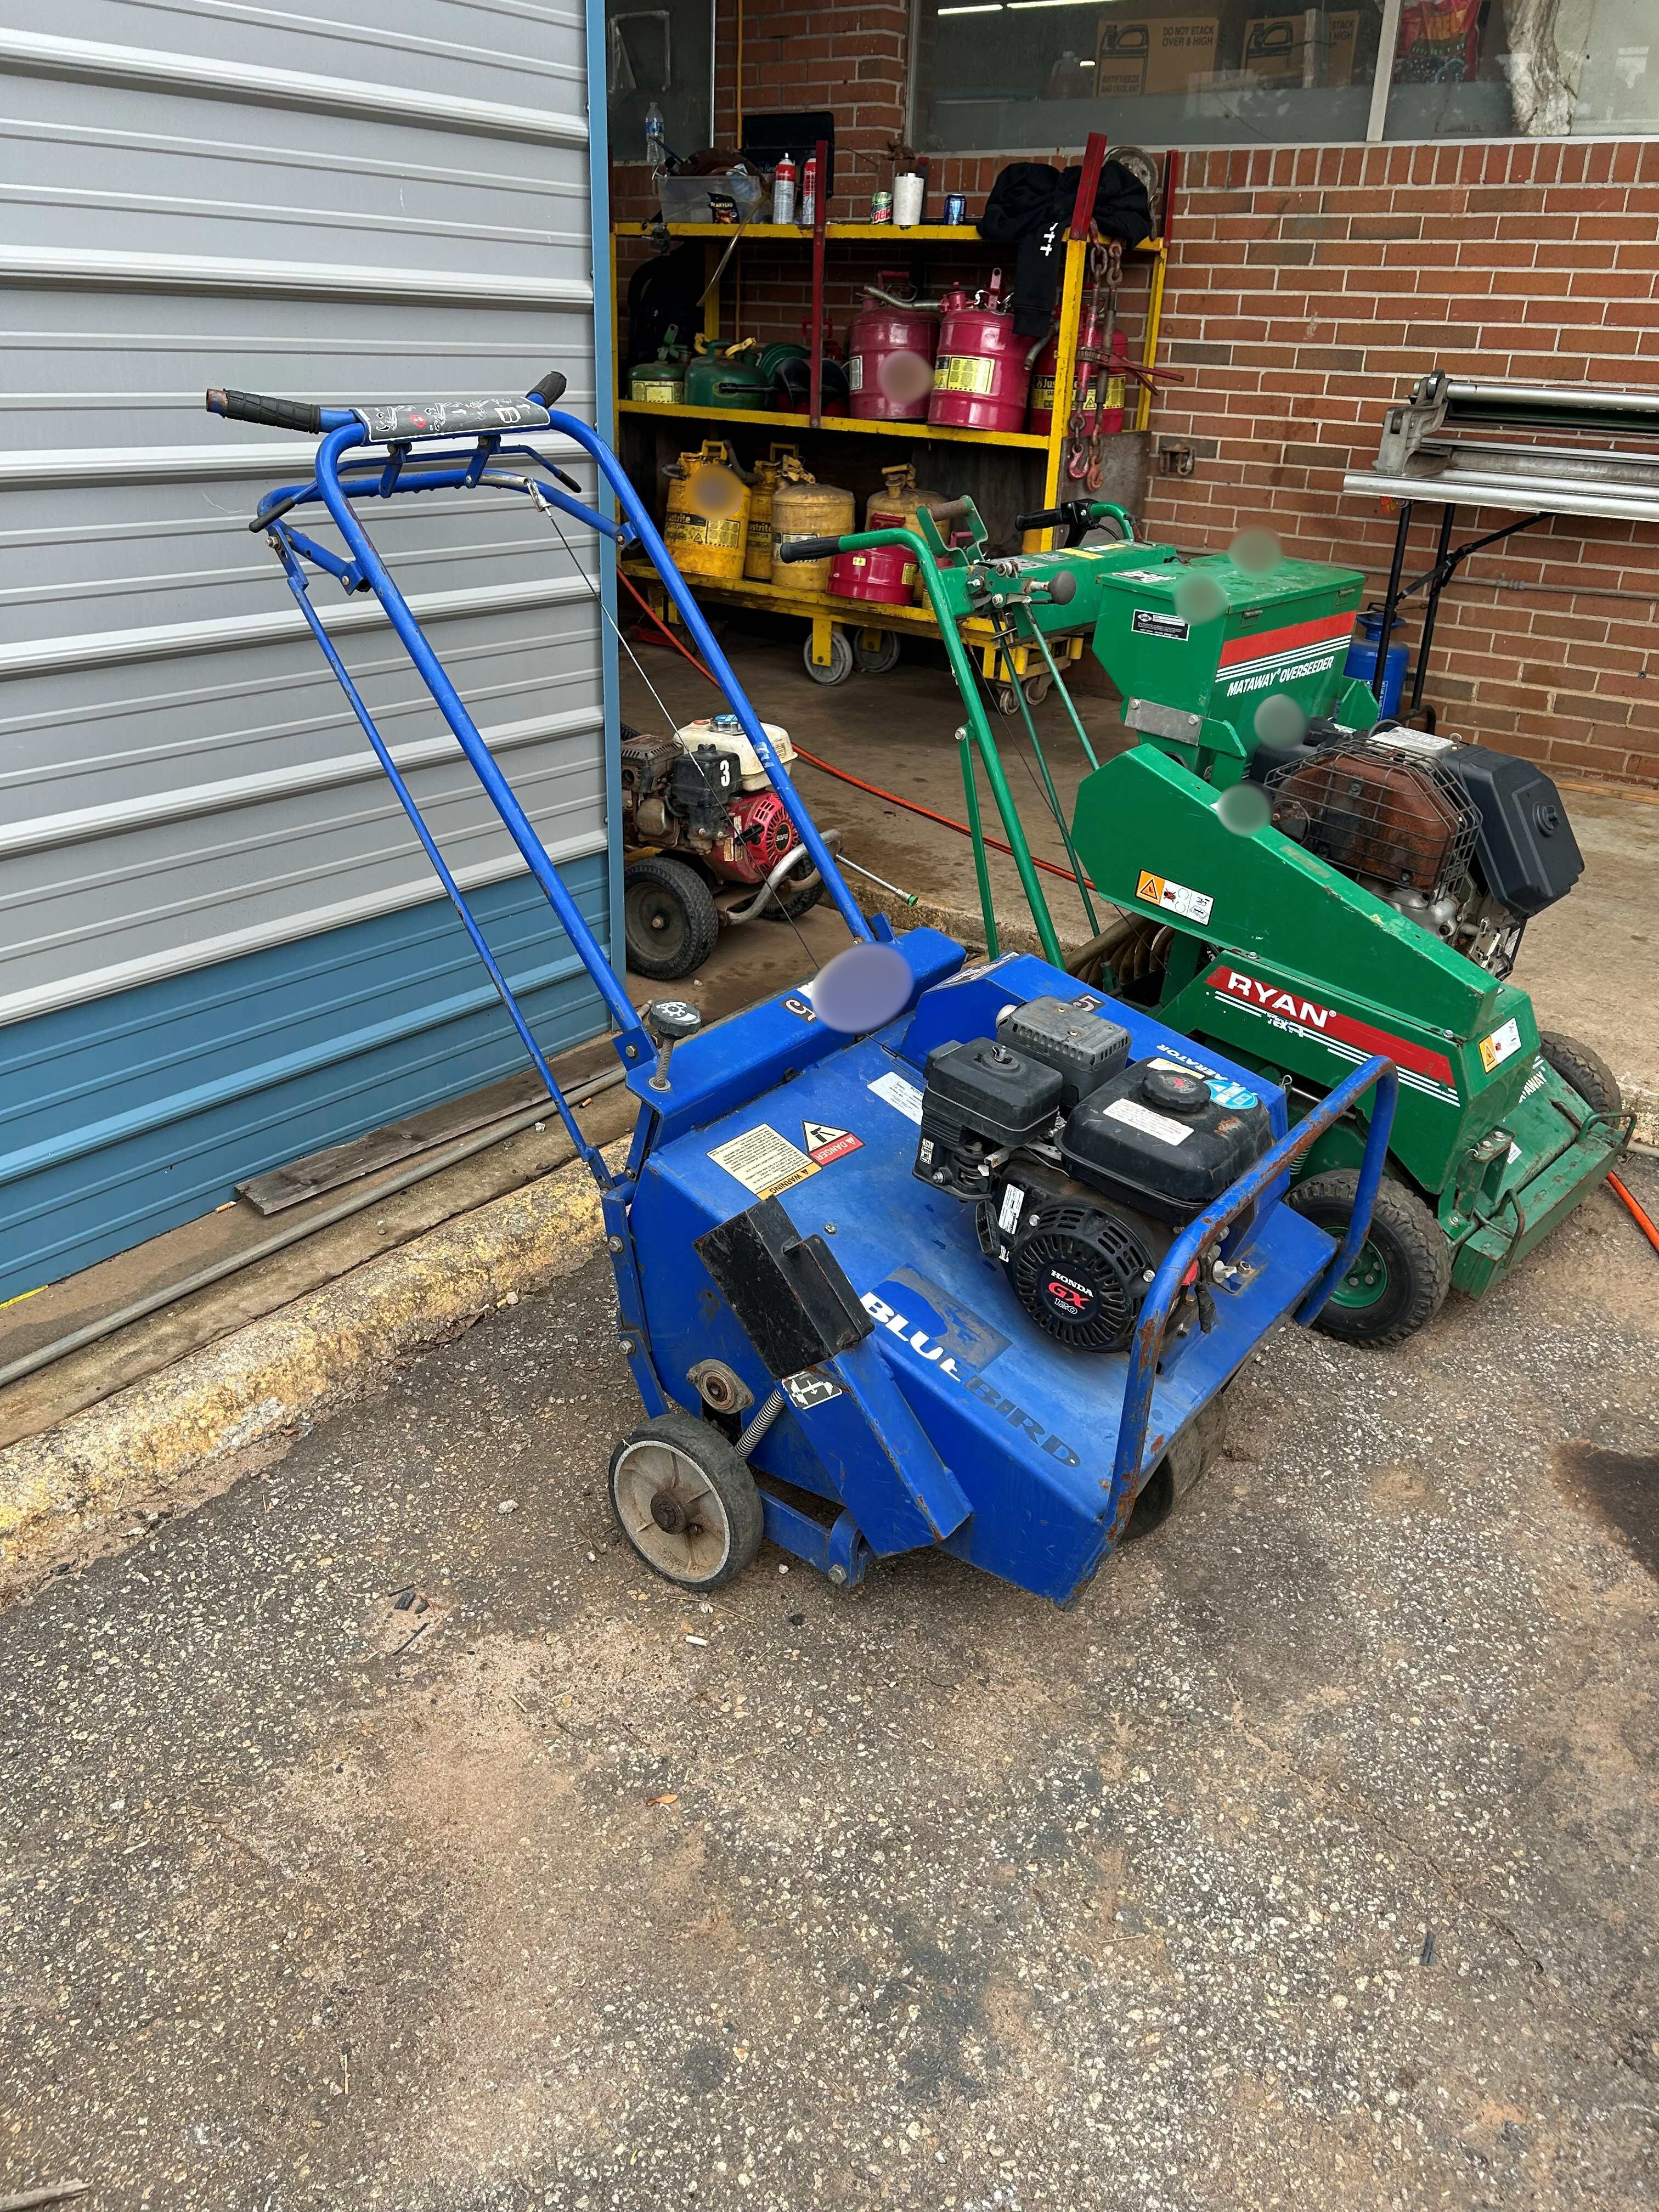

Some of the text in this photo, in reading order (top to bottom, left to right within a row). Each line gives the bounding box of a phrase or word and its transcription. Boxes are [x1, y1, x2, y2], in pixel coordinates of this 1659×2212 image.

[1162, 37, 1184, 47] OVER
[1193, 36, 1213, 46] HIGH
[1163, 25, 1214, 36] DO NOT STACK
[1227, 656, 1334, 697] MATAWAY OVERSEEDER
[719, 759, 731, 787] 3
[1227, 971, 1329, 1028] RYAN
[1156, 1044, 1229, 1080] AERATOR
[816, 1140, 849, 1162] DANGER
[769, 1172, 803, 1195] WARNING
[1048, 1281, 1091, 1310] GX
[1050, 1269, 1094, 1298] HONDA
[1053, 1297, 1078, 1314] 120
